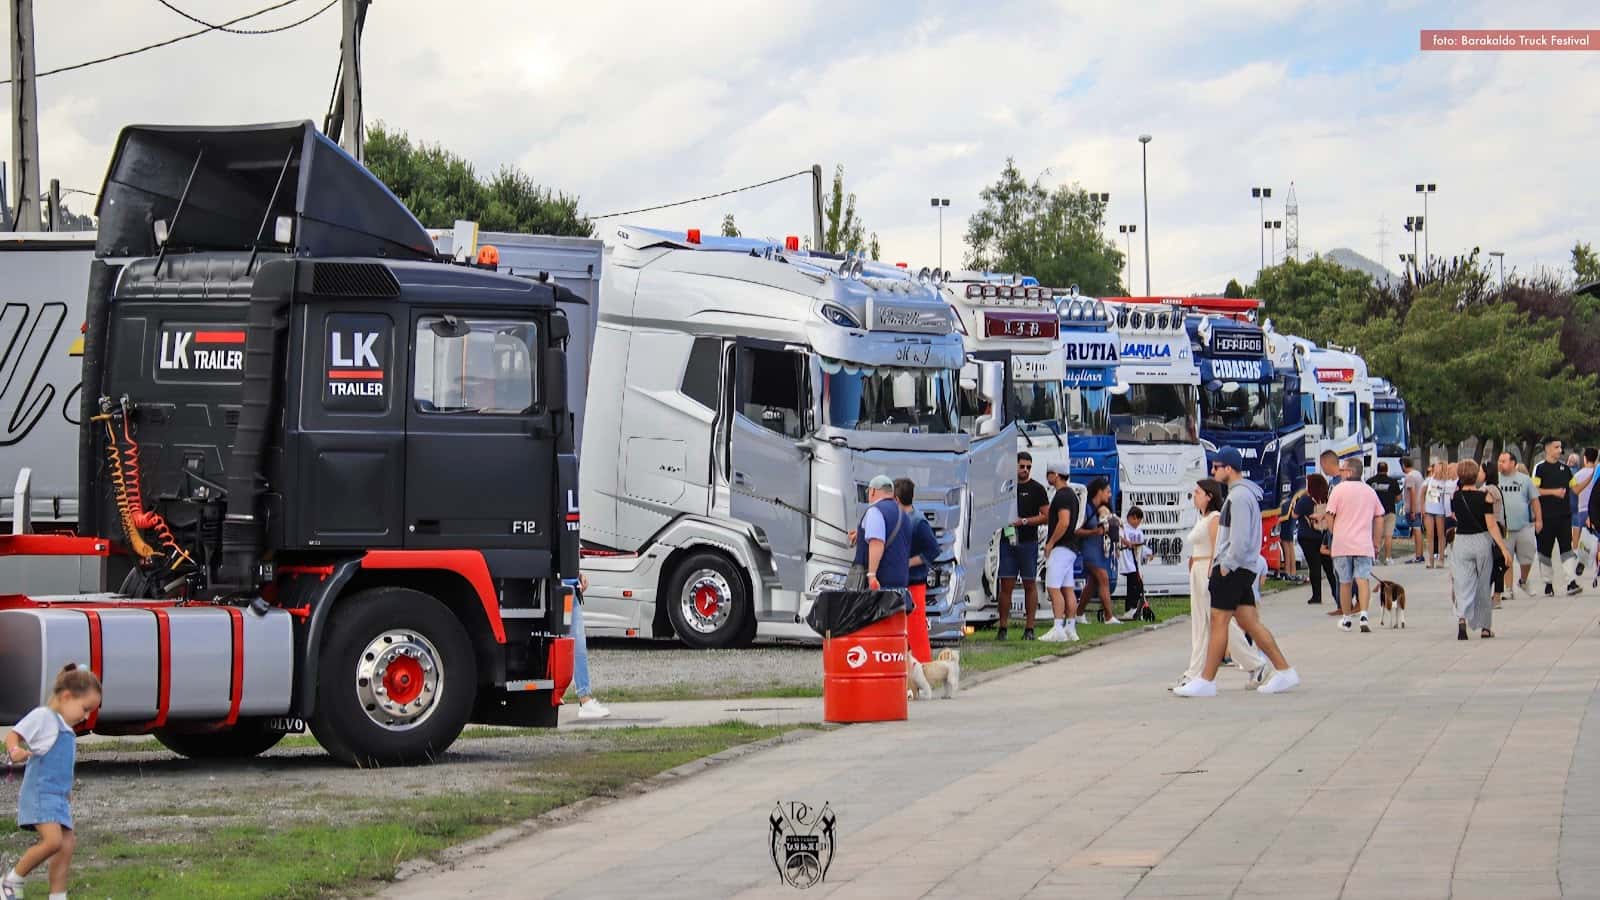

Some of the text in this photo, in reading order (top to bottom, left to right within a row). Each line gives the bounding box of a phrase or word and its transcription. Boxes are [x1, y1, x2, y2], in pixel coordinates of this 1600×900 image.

[160, 331, 243, 370] LK TRAILER
[332, 332, 380, 367] LK
[1062, 343, 1118, 361] RUTIA
[329, 382, 384, 396] TRAILER
[513, 521, 536, 533] F12
